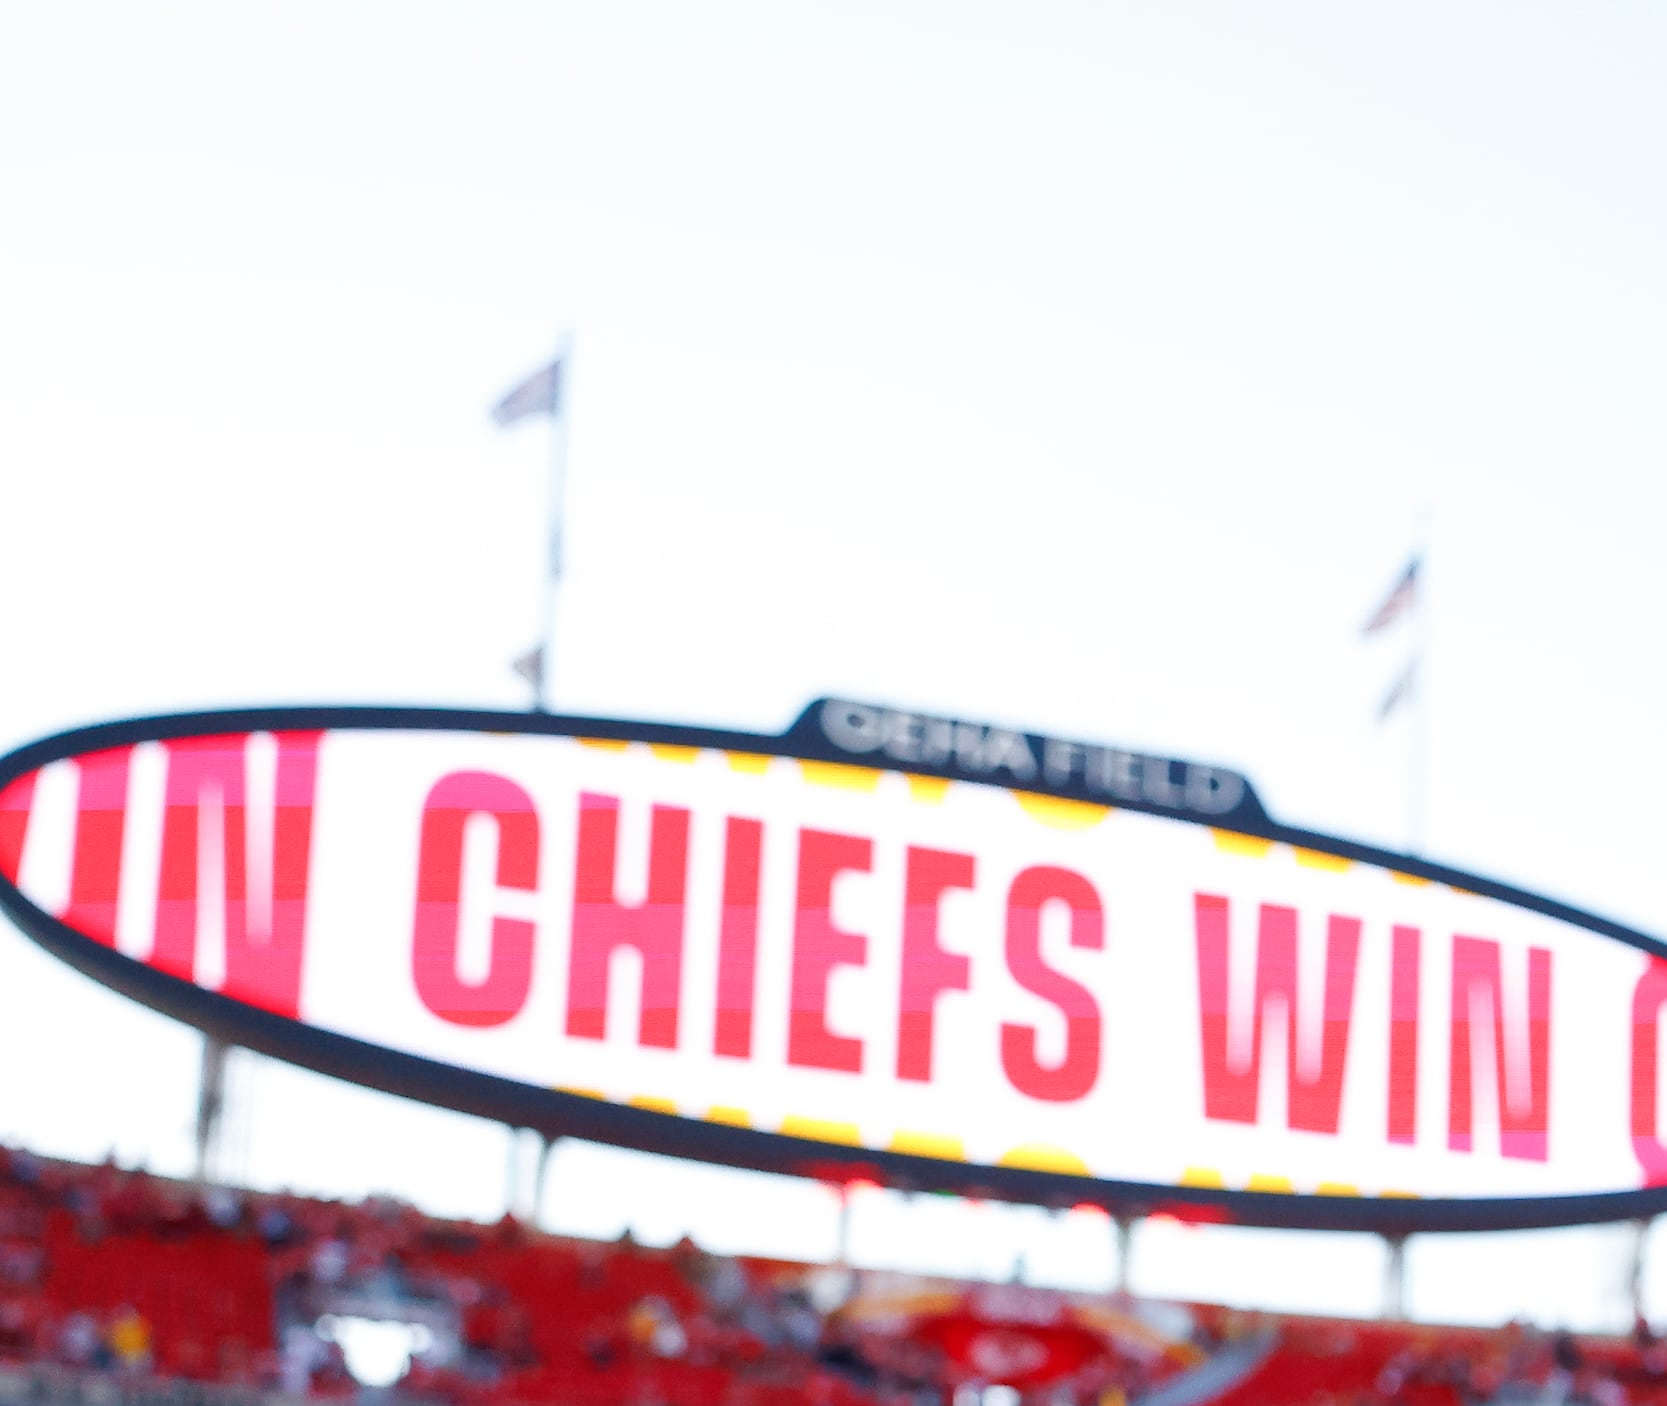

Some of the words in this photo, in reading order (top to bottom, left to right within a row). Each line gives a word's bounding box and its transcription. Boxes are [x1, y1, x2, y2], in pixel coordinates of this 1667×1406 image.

[0, 730, 328, 1020] IN
[411, 769, 1107, 1103] CHIEFS
[1193, 890, 1553, 1164] WIN
